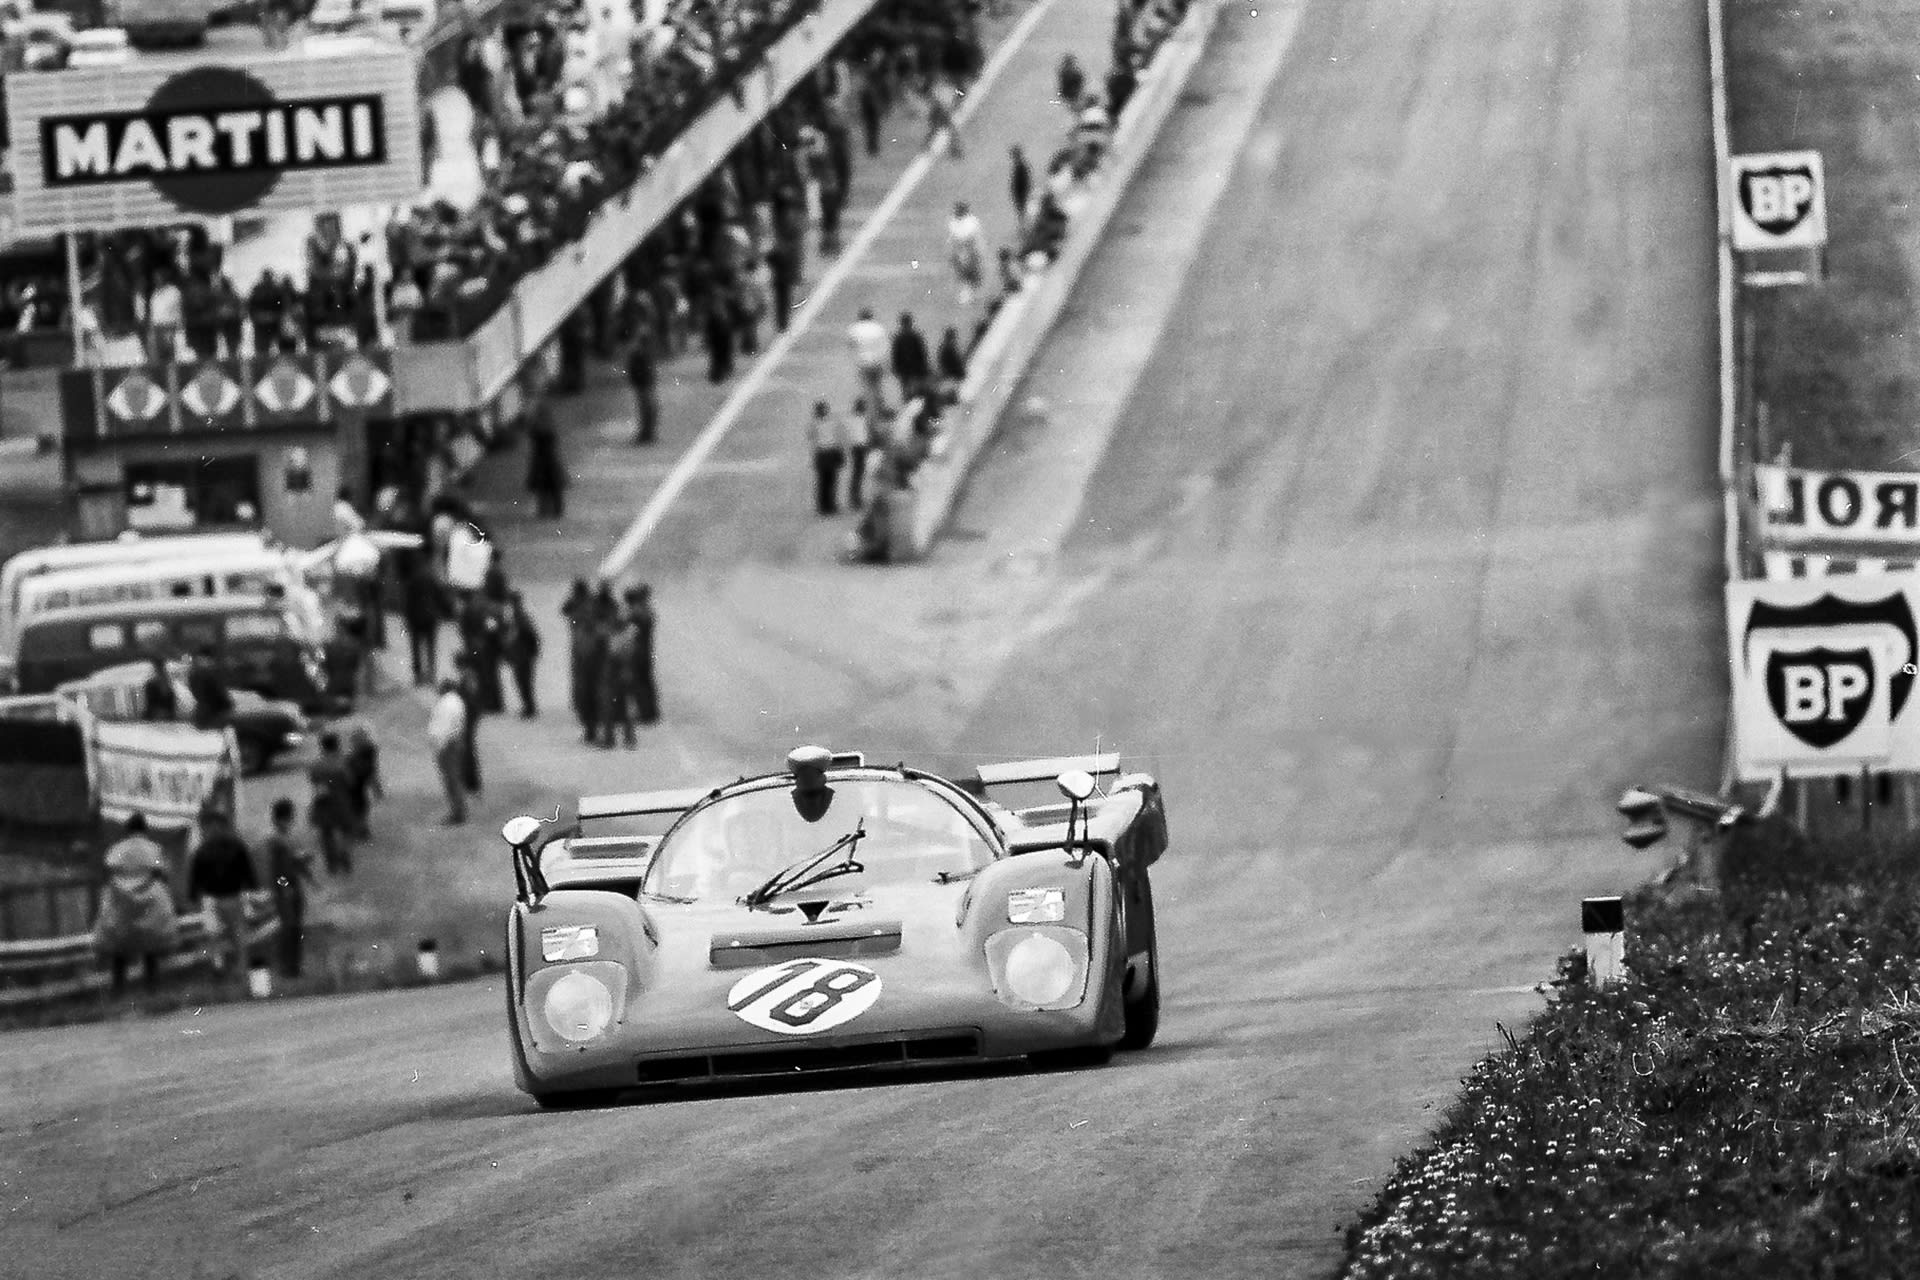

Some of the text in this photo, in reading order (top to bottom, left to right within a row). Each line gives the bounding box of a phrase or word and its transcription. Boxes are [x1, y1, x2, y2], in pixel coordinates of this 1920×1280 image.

[55, 103, 374, 177] MARTINI
[1750, 174, 1812, 222] BP
[1782, 664, 1869, 722] BP
[728, 961, 877, 1027] 18
